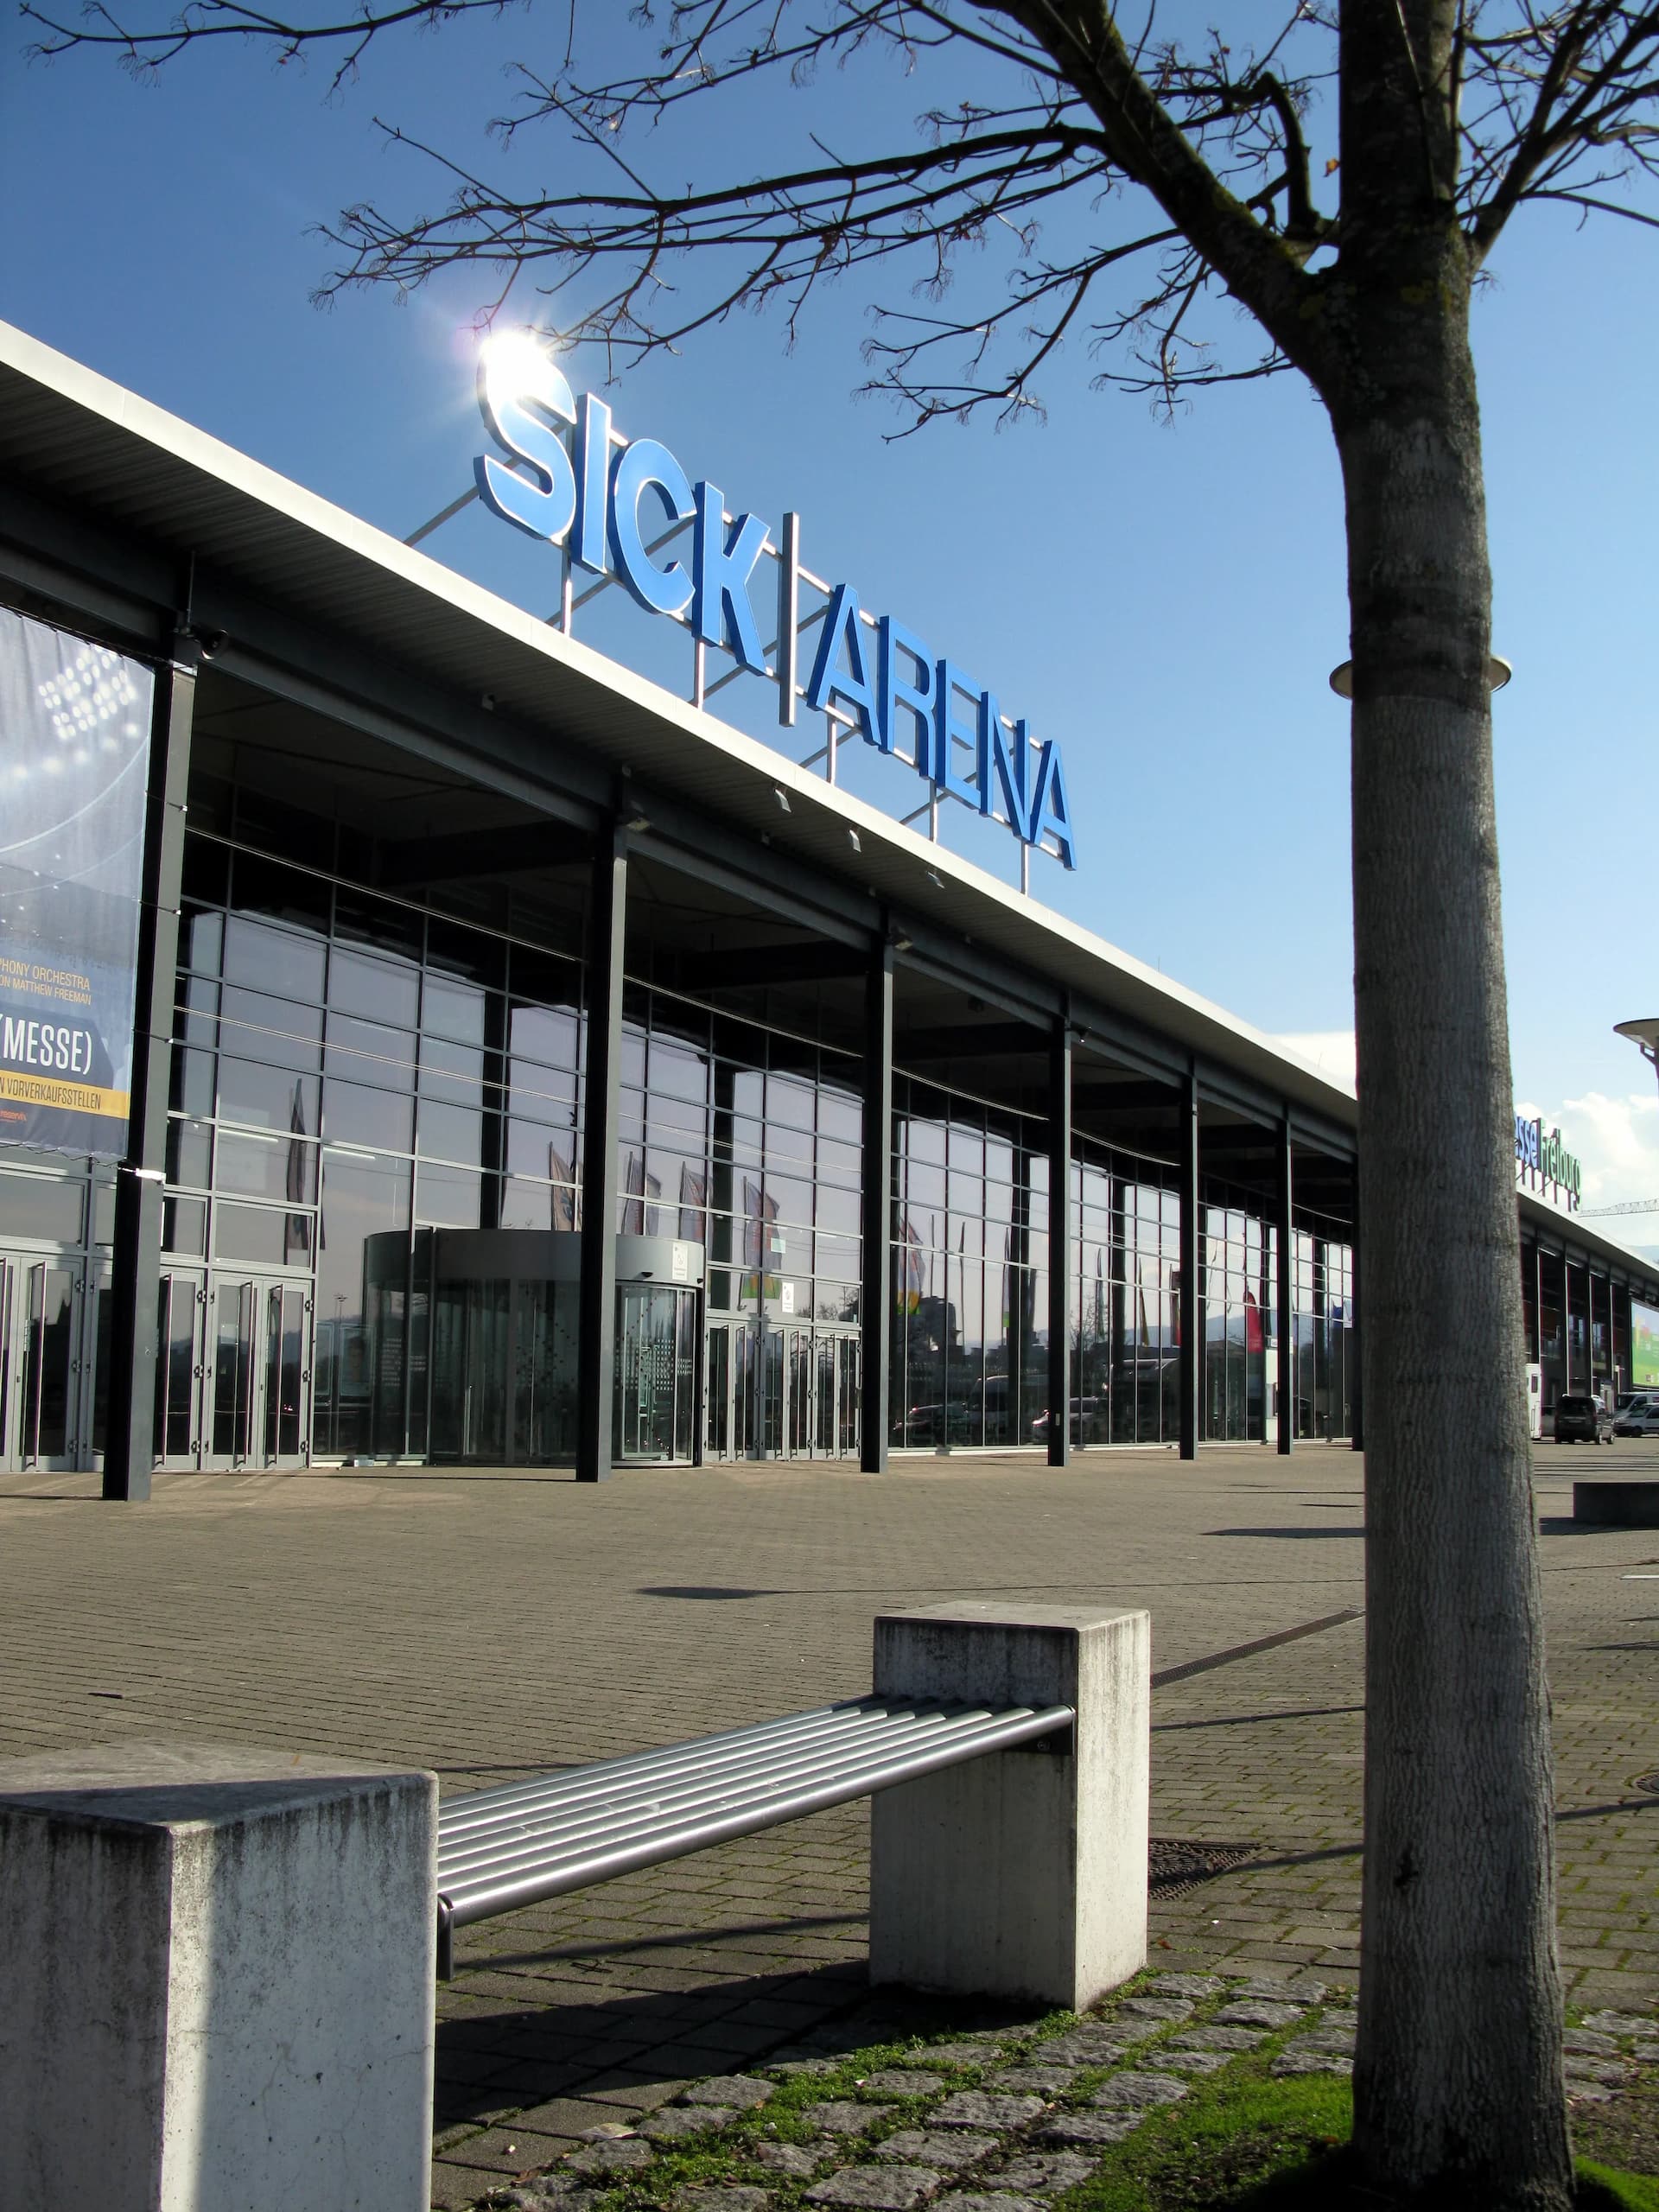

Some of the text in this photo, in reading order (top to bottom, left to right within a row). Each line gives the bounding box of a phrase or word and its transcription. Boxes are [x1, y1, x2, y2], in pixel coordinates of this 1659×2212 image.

[474, 335, 1077, 871] SICK ARENA
[13, 977, 53, 996] MATTHEW
[54, 987, 92, 1006] FREEMAN
[33, 965, 90, 991] ORCHESTRA
[7, 1077, 101, 1110] VORVERKAUFSSTELLEN
